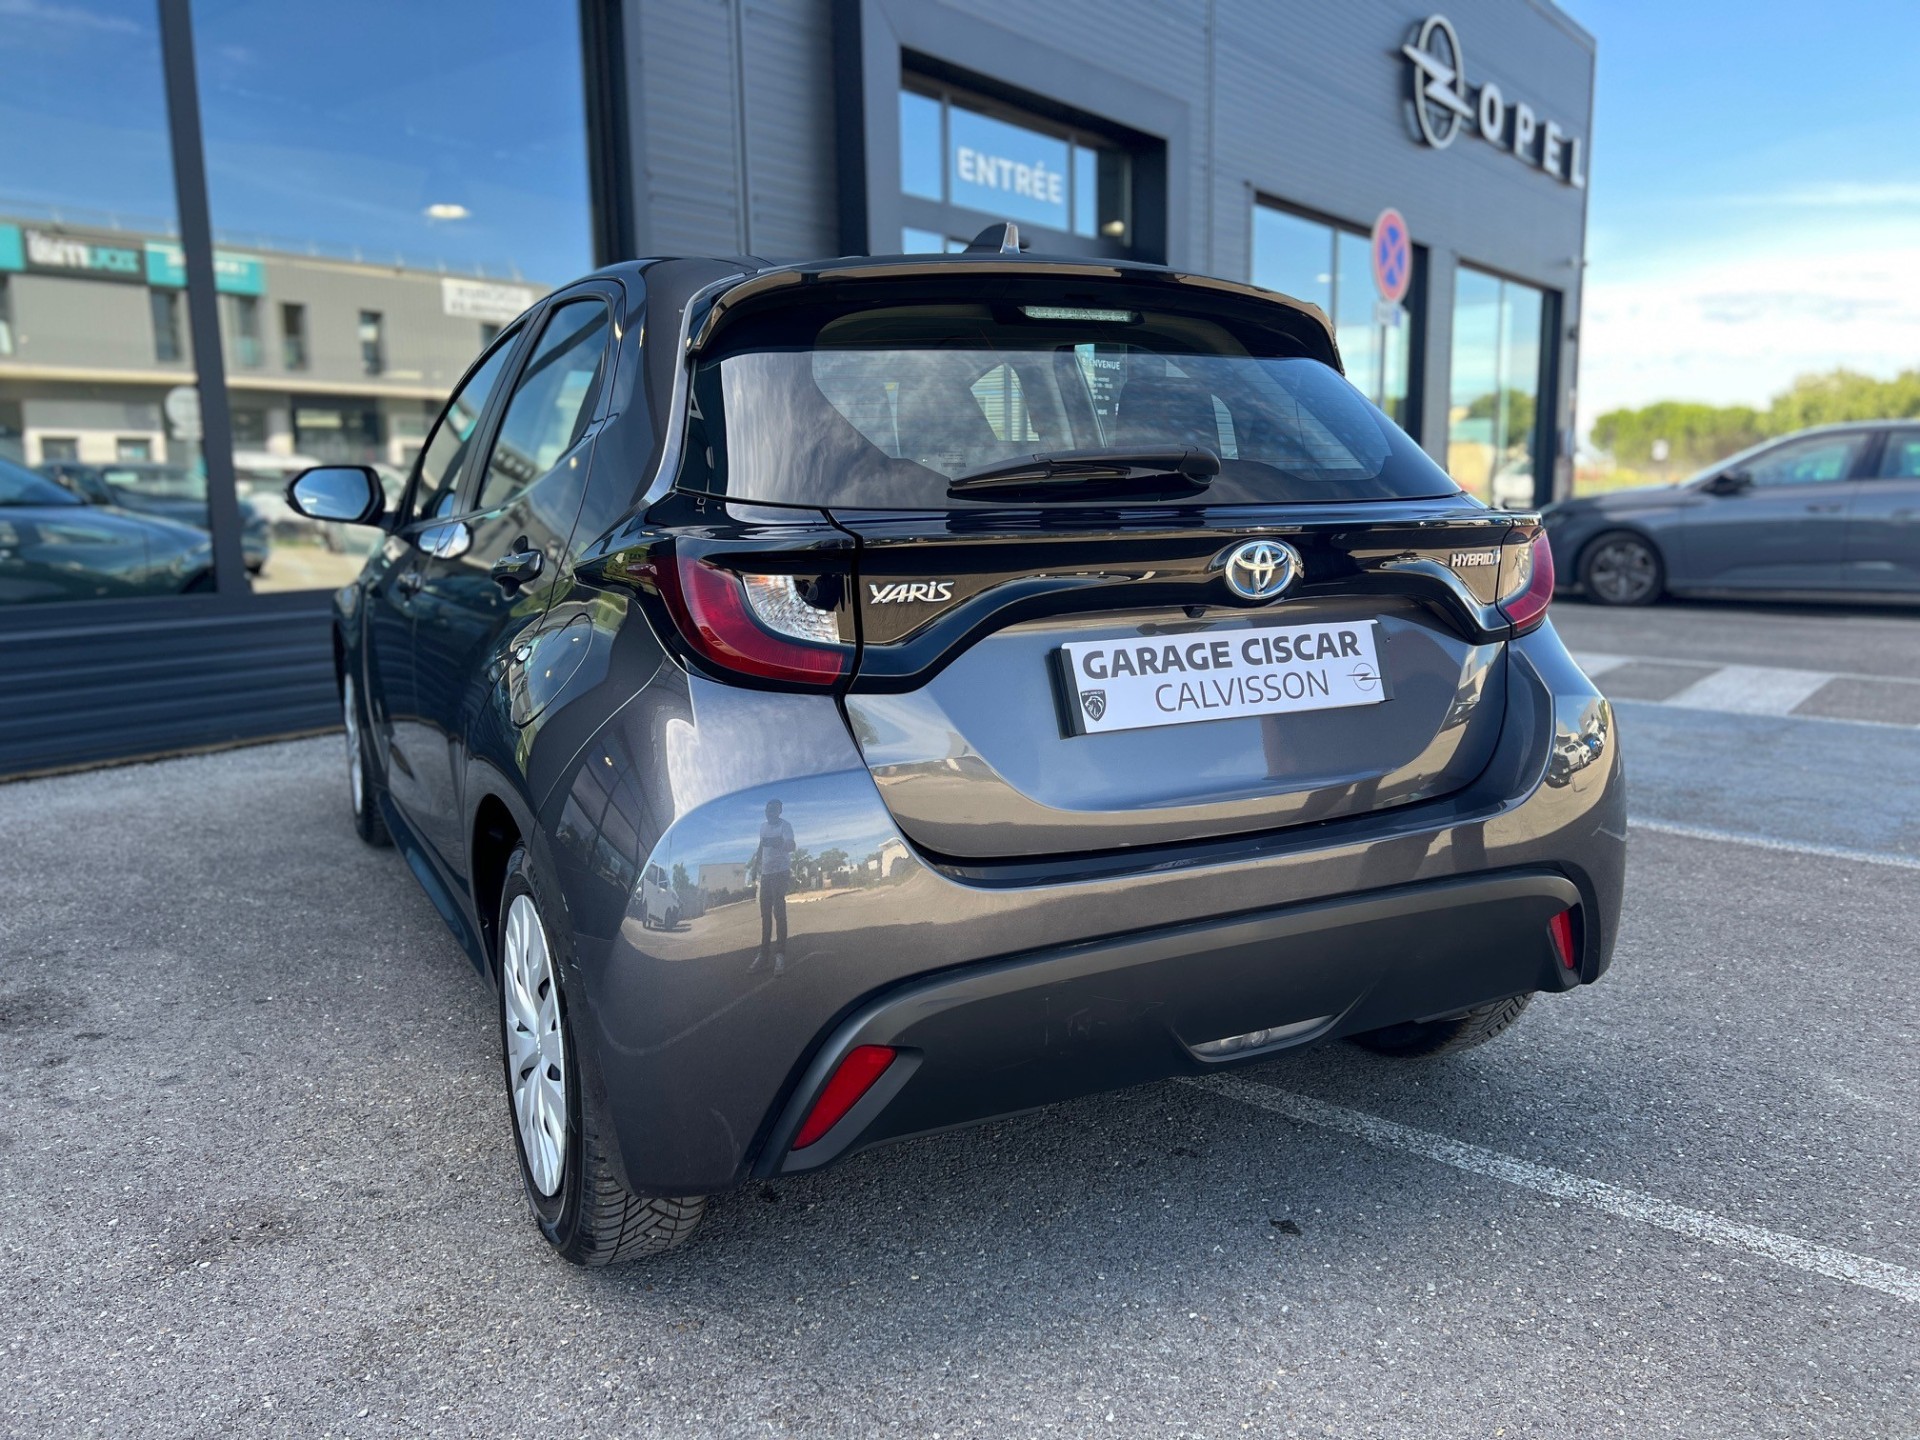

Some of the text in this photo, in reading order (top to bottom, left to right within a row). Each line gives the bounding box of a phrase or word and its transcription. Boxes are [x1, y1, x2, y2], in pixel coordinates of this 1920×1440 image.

[1478, 81, 1586, 189] OPEL
[957, 145, 1063, 206] ENTRÉE
[1450, 552, 1494, 567] HYBRID
[1082, 630, 1362, 680] GARAGE CISCAR
[1155, 669, 1330, 712] CALVISSON
